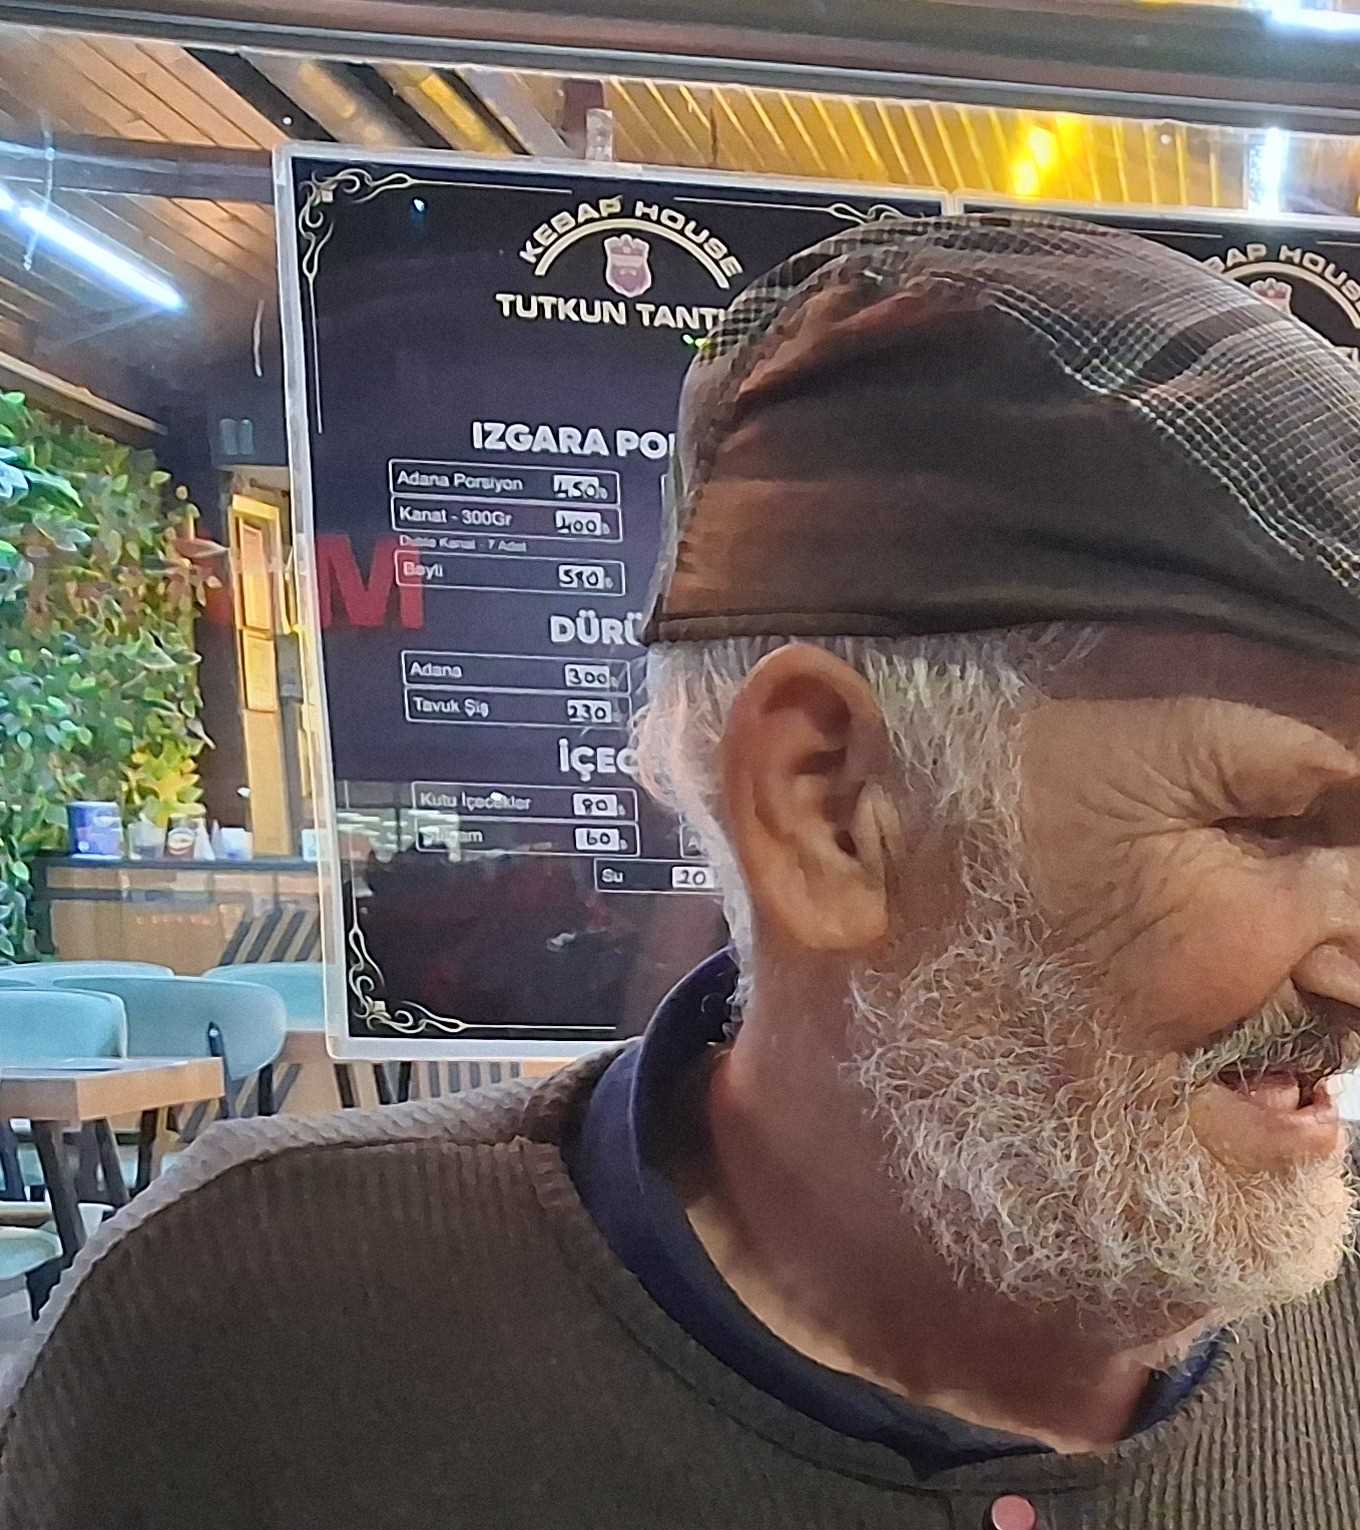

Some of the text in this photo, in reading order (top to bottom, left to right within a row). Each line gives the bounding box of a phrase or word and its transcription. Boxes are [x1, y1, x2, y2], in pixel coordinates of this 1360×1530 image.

[519, 196, 744, 278] KEBAP HOUSE
[1201, 243, 1267, 274] BAP
[496, 293, 727, 331] TUTKUN TANT
[472, 421, 611, 457] IZGARA
[397, 470, 449, 488] Adana
[454, 473, 524, 493] Porsiyon
[400, 506, 447, 524] Kanat
[462, 510, 513, 527] 300Gr
[410, 661, 463, 679] Adana
[412, 696, 460, 714] Tavuk
[421, 791, 457, 808] Kutu
[602, 867, 624, 883] Su
